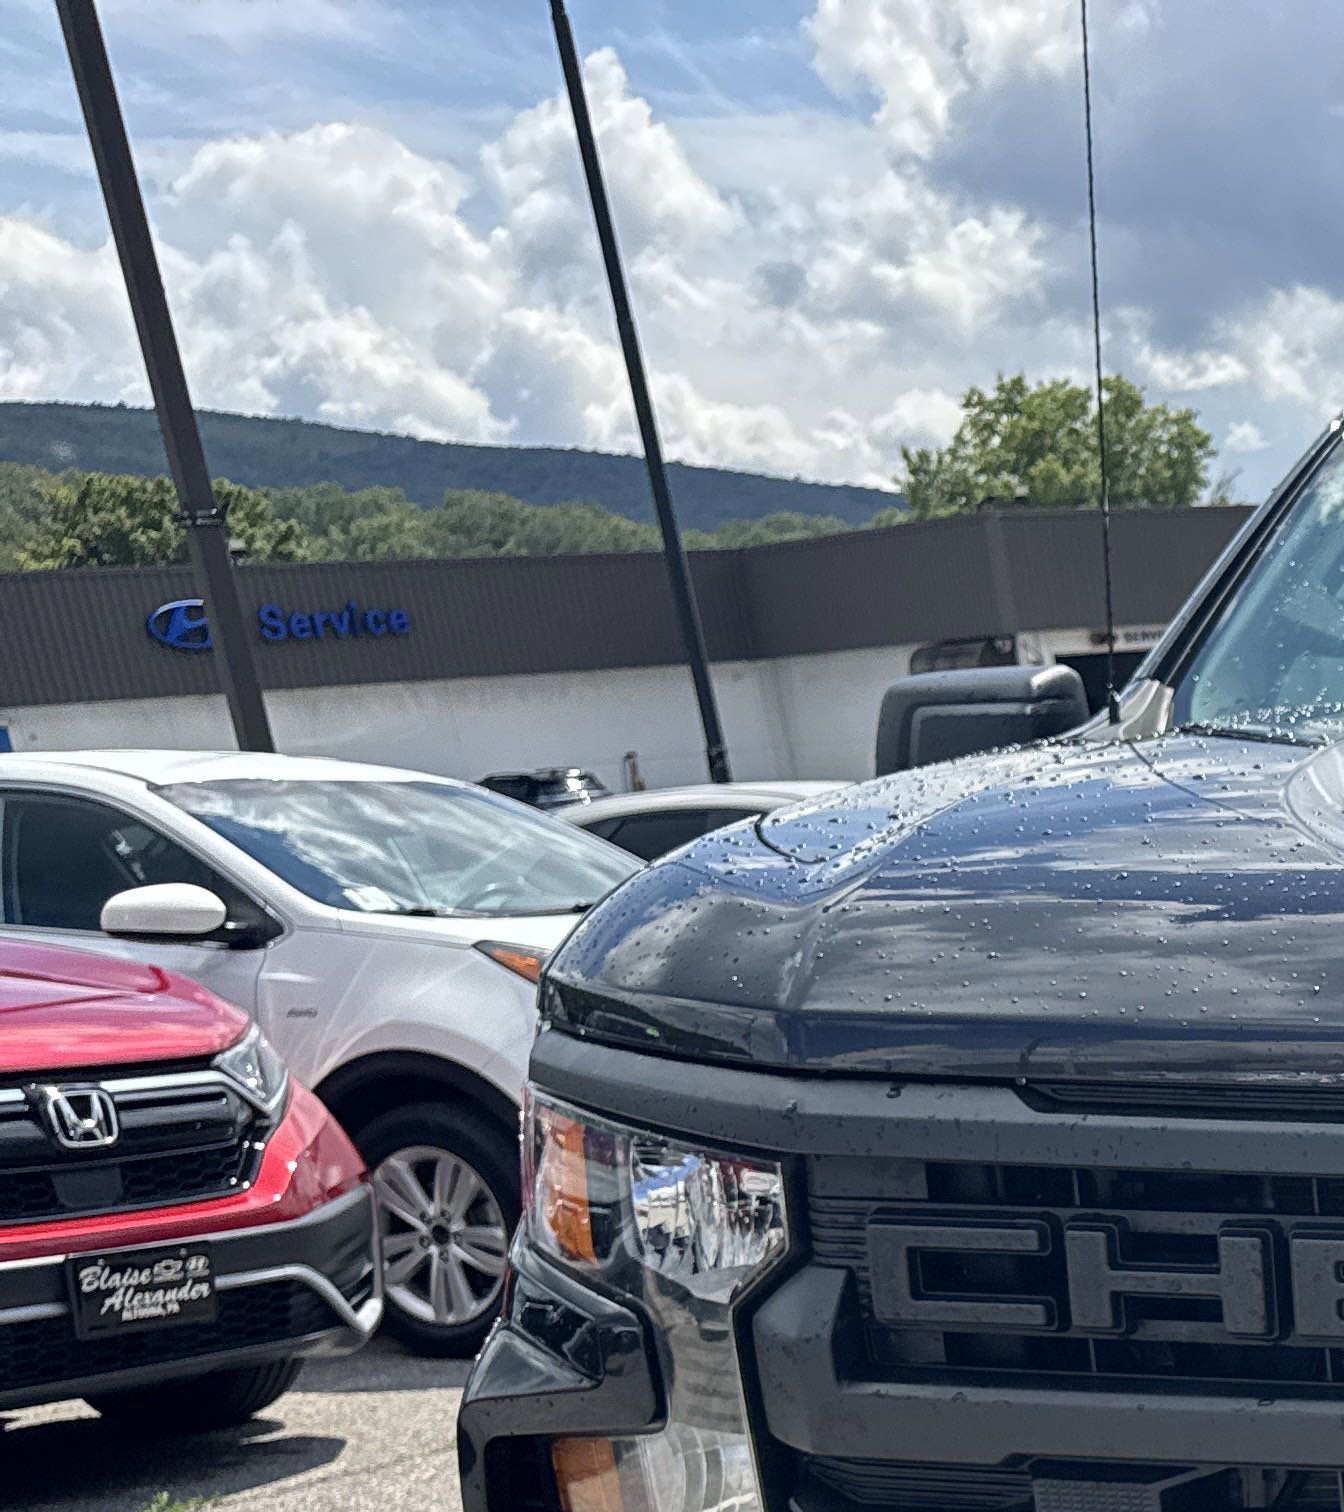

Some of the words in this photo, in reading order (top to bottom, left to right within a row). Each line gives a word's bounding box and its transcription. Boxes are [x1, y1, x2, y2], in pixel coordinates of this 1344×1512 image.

[256, 601, 411, 641] Service
[79, 1264, 152, 1293] Blaise
[100, 1278, 212, 1316] Alexander
